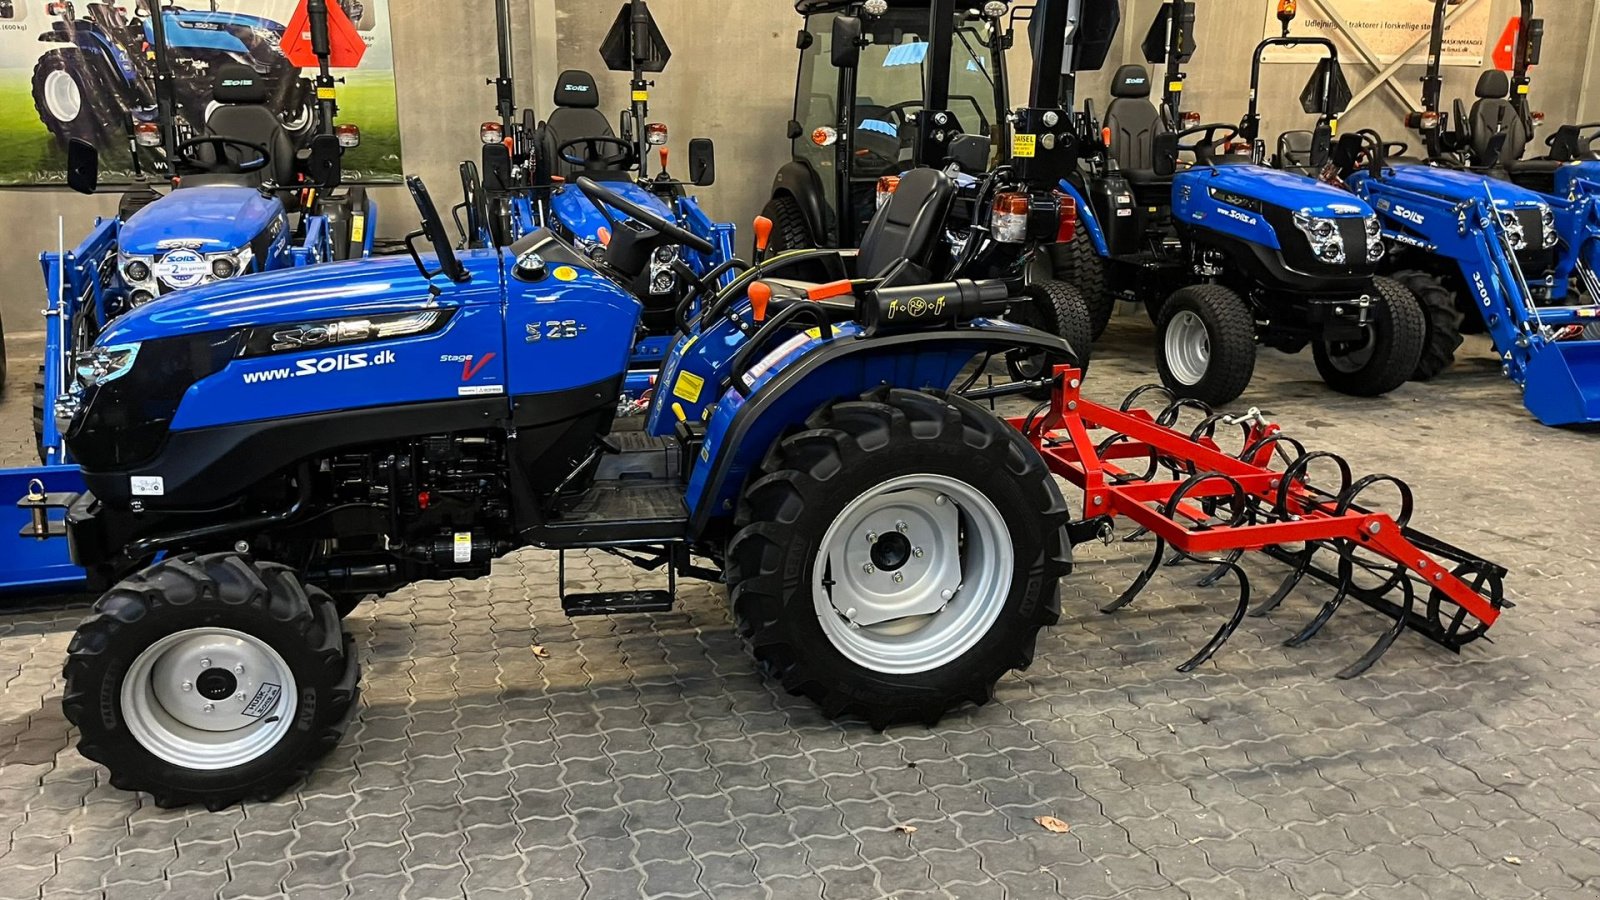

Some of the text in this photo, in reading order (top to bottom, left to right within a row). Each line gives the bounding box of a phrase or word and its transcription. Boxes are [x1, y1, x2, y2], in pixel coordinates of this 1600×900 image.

[1384, 21, 1419, 31] forskellige
[1472, 271, 1491, 307] 3200
[525, 321, 542, 342] S
[439, 354, 474, 363] Stage
